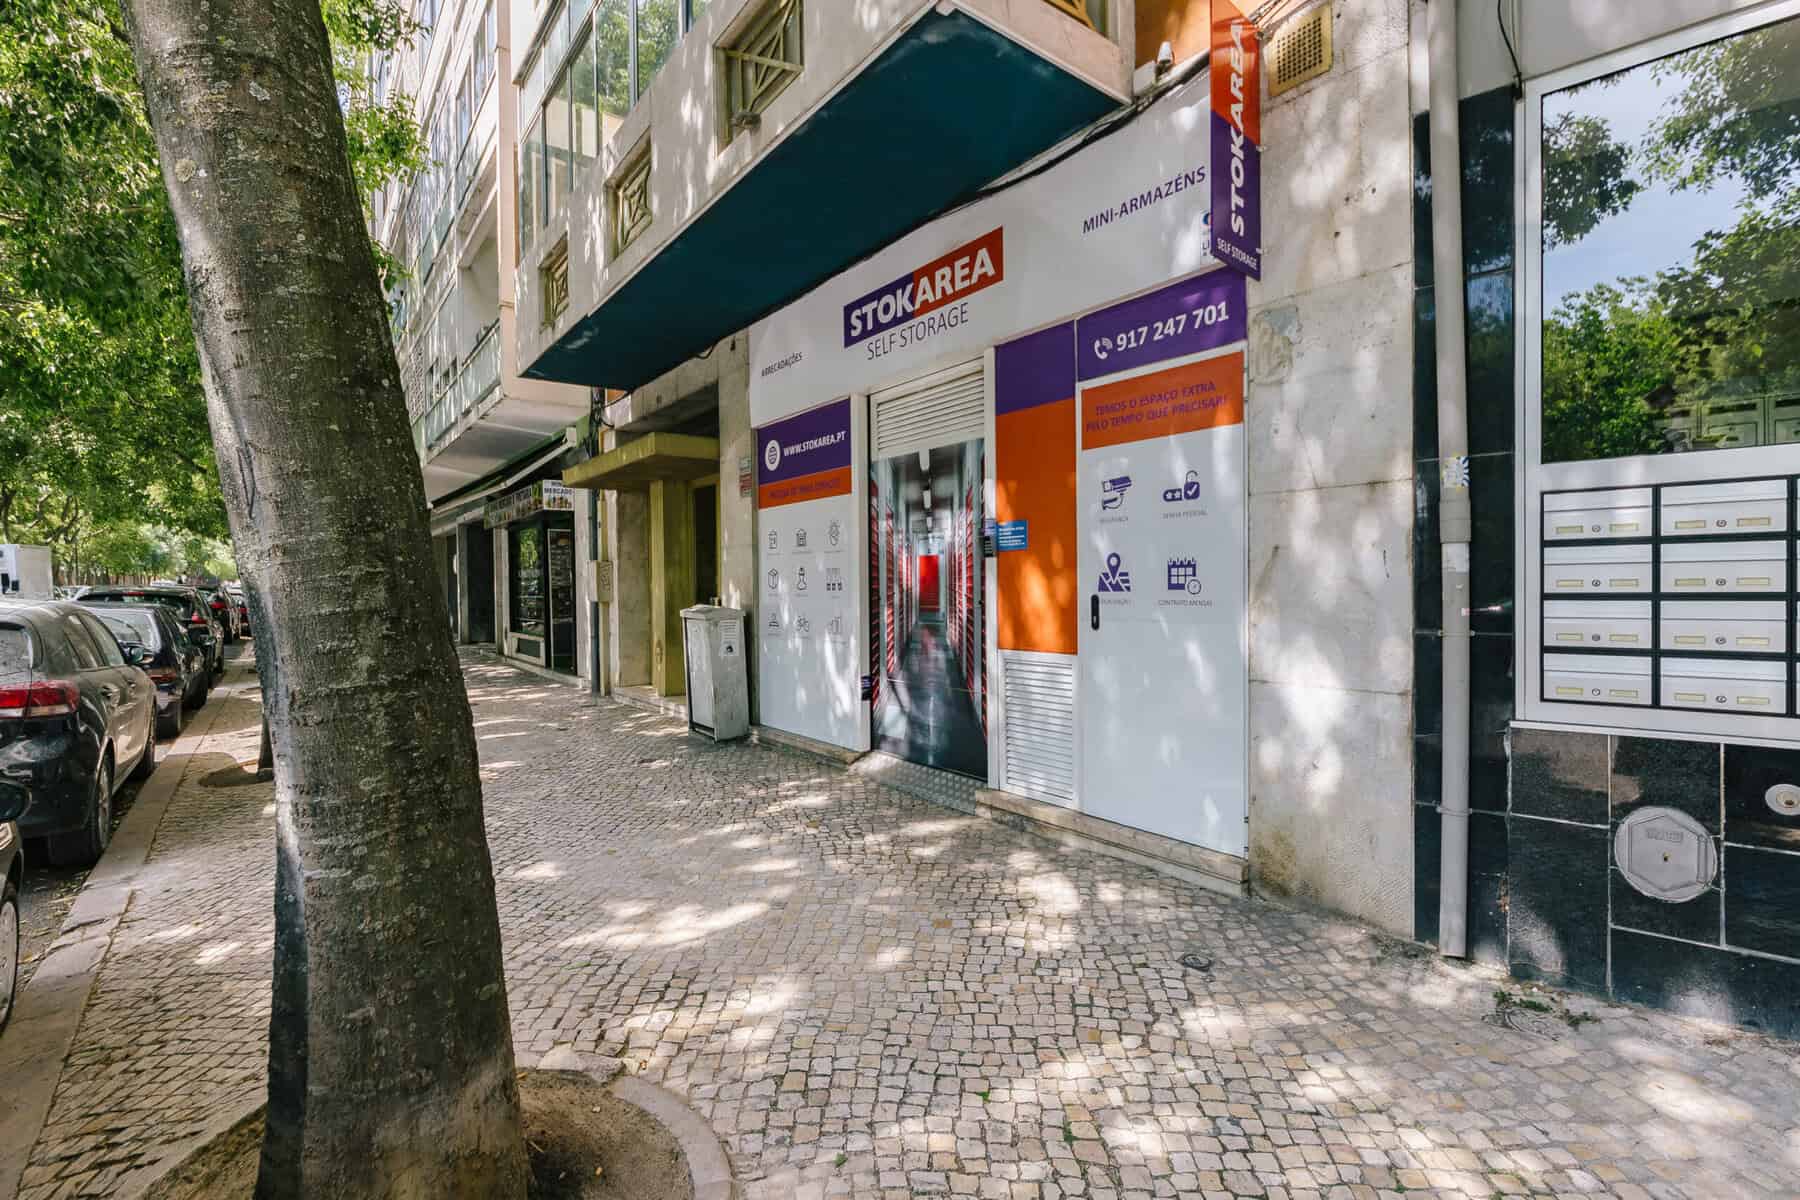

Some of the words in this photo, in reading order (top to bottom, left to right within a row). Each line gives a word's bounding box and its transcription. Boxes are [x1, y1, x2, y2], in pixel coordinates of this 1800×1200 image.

[1230, 24, 1245, 237] STOKAREA
[1082, 166, 1206, 235] MINI-ARMAZÉNS
[1217, 237, 1231, 255] SELF
[1231, 245, 1257, 271] STORAGE
[850, 247, 996, 337] STOKAREA
[866, 333, 896, 361] SELF
[899, 302, 969, 348] STORAGE
[1116, 326, 1149, 352] 917
[1152, 313, 1187, 342] 247
[1192, 300, 1230, 329] 701
[1096, 401, 1127, 417] TEMOS
[1129, 399, 1137, 409] O
[1139, 390, 1178, 406] ESPAÇO
[1182, 381, 1217, 397] EXTRA
[1111, 412, 1144, 426] TEMPO
[1147, 406, 1169, 421] QUE
[783, 430, 847, 457] WWW.STOKAREA.PT
